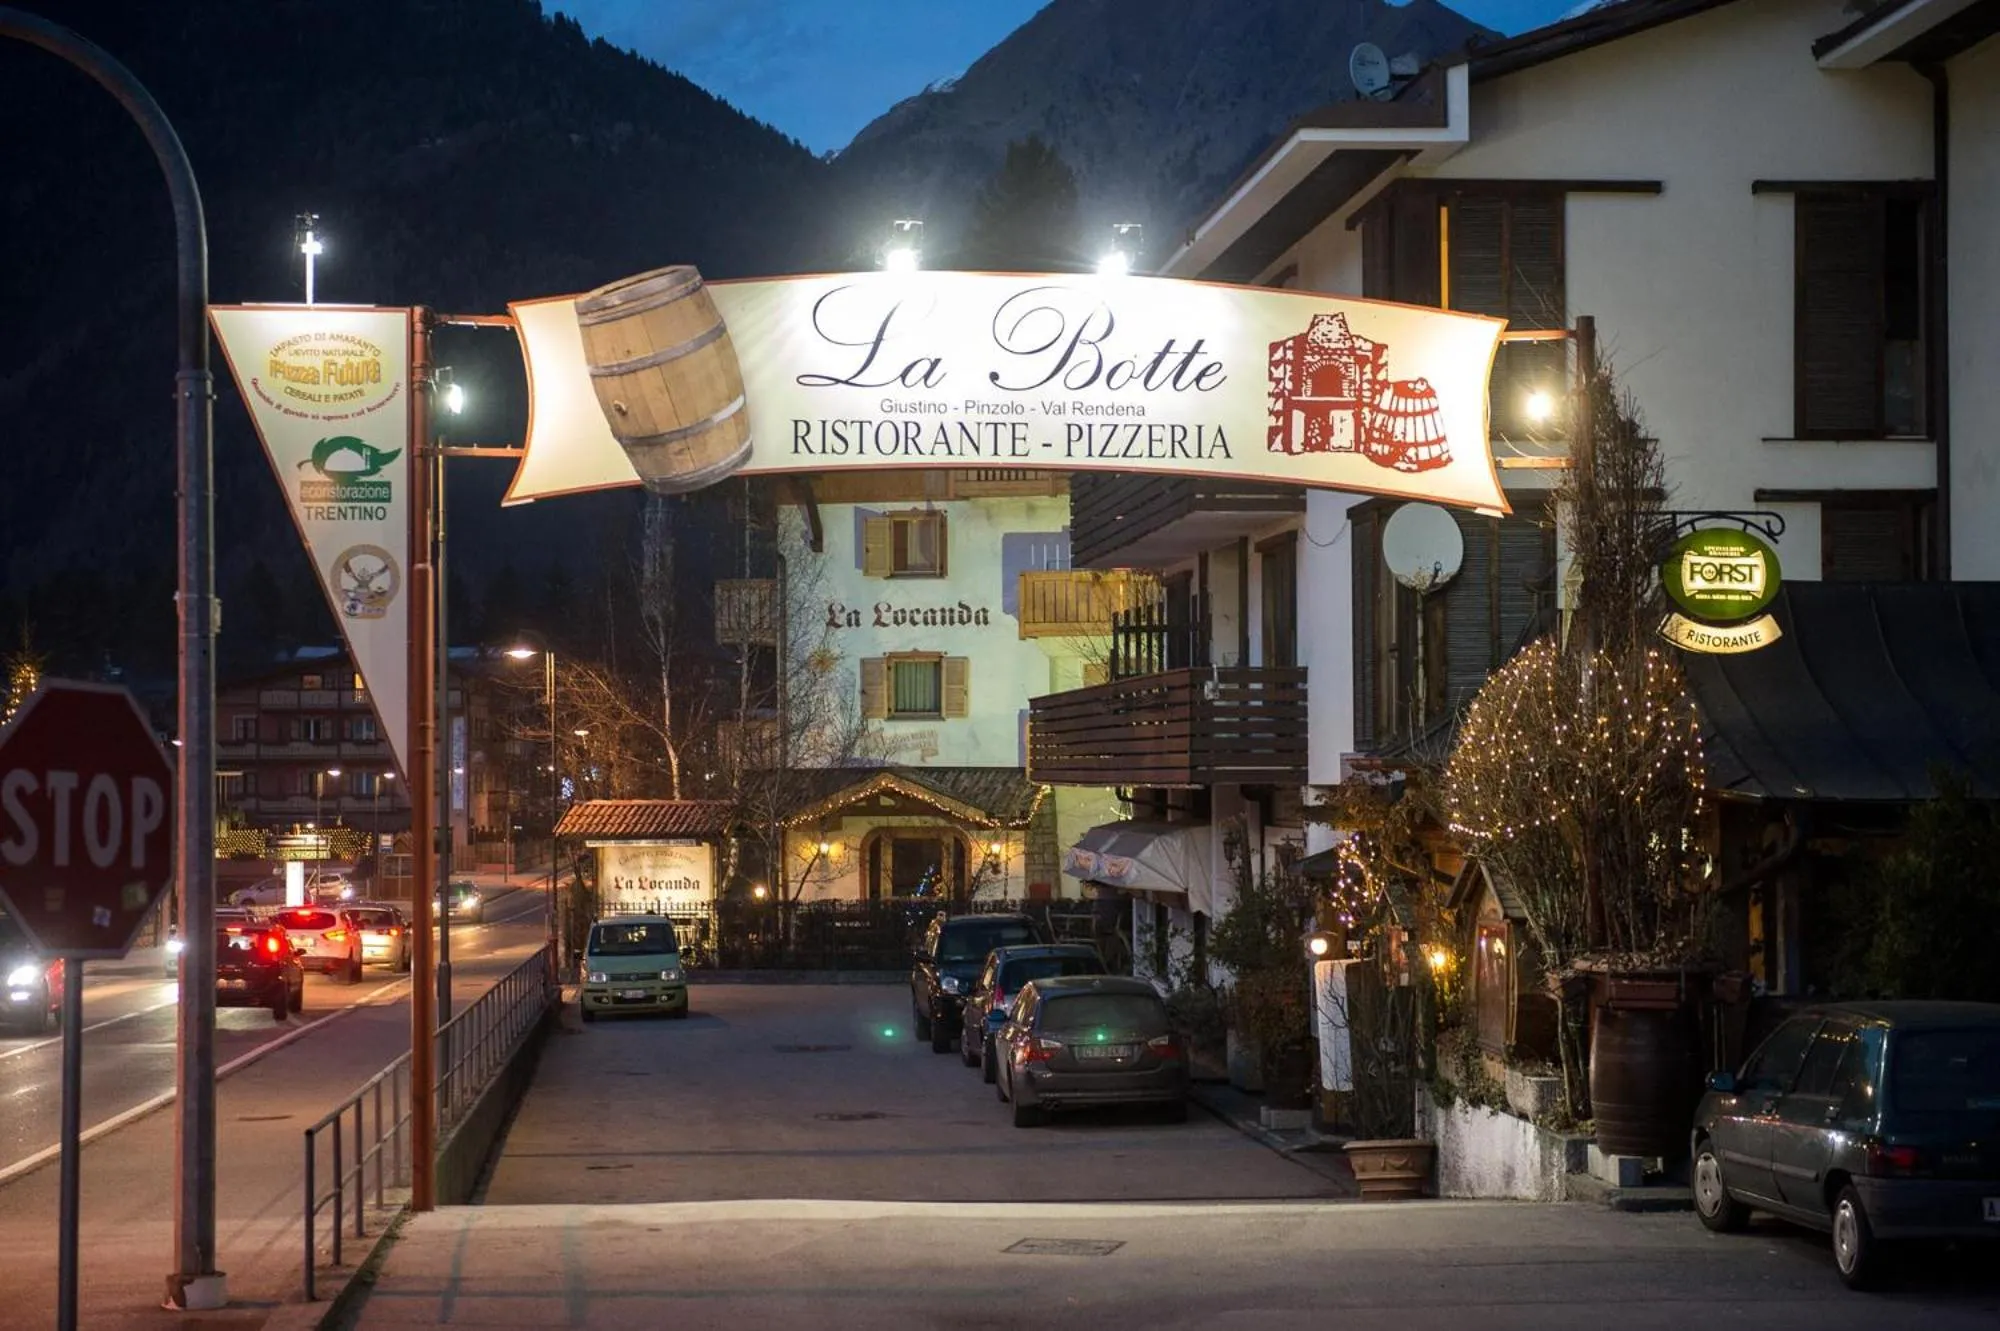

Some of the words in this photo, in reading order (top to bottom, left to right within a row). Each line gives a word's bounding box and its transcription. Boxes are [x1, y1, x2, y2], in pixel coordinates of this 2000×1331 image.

[314, 333, 326, 341] DI
[796, 284, 947, 389] La
[989, 286, 1227, 392] Botte
[269, 359, 320, 385] Pizza
[284, 386, 321, 402] CEREALI
[333, 388, 366, 402] PATATE
[880, 398, 948, 415] Giustino
[965, 400, 1025, 416] Pinzolo
[1041, 401, 1068, 416] Val
[1073, 402, 1146, 417] Rendena
[790, 419, 1031, 457] RISTORANTE
[1064, 422, 1233, 459] PIZZERIA
[304, 506, 386, 520] TRENTINO
[1689, 562, 1759, 582] FORST
[826, 602, 861, 628] La
[873, 601, 990, 627] Locanda
[1686, 630, 1762, 648] RISTORANTE
[0, 768, 164, 868] STOP
[614, 876, 633, 890] La
[638, 876, 700, 890] Locanda
